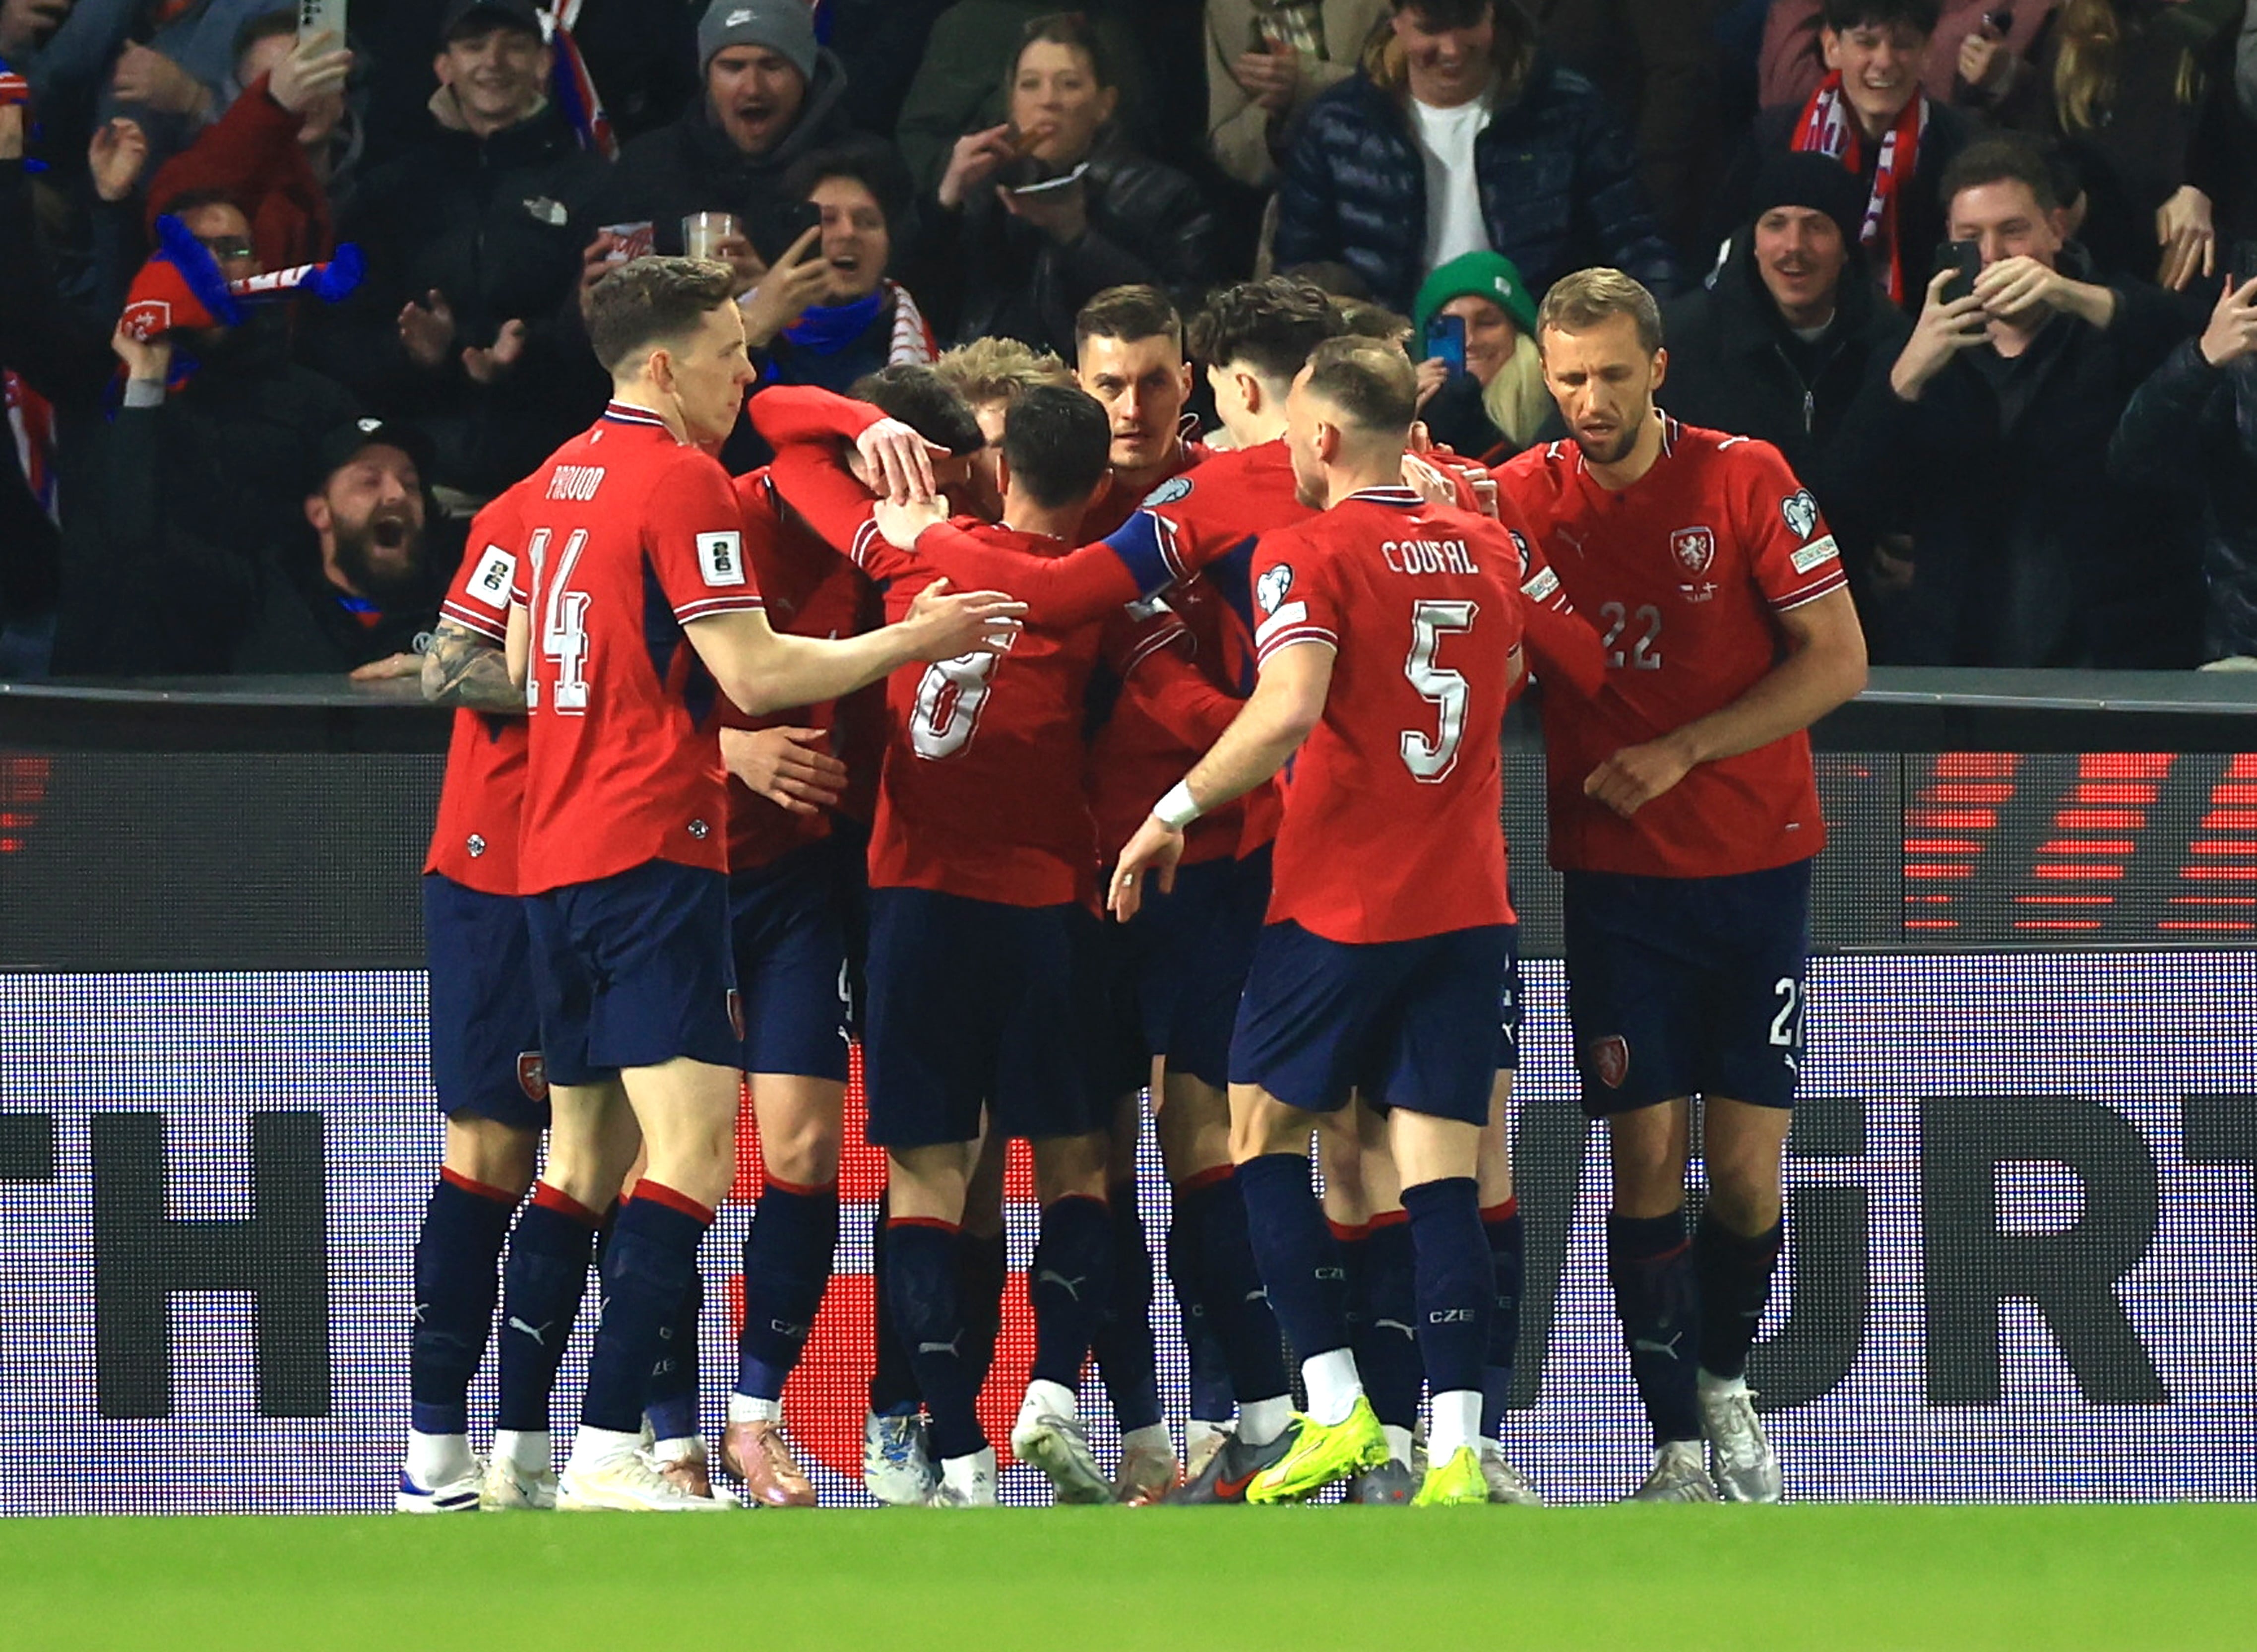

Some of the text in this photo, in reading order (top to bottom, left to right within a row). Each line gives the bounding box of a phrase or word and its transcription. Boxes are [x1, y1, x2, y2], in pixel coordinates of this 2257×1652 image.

[1381, 539, 1479, 574] COUFAL
[527, 528, 592, 716] 14
[1600, 602, 1661, 669] 22
[1400, 599, 1480, 783] 5
[1429, 1309, 1474, 1324] CZE
